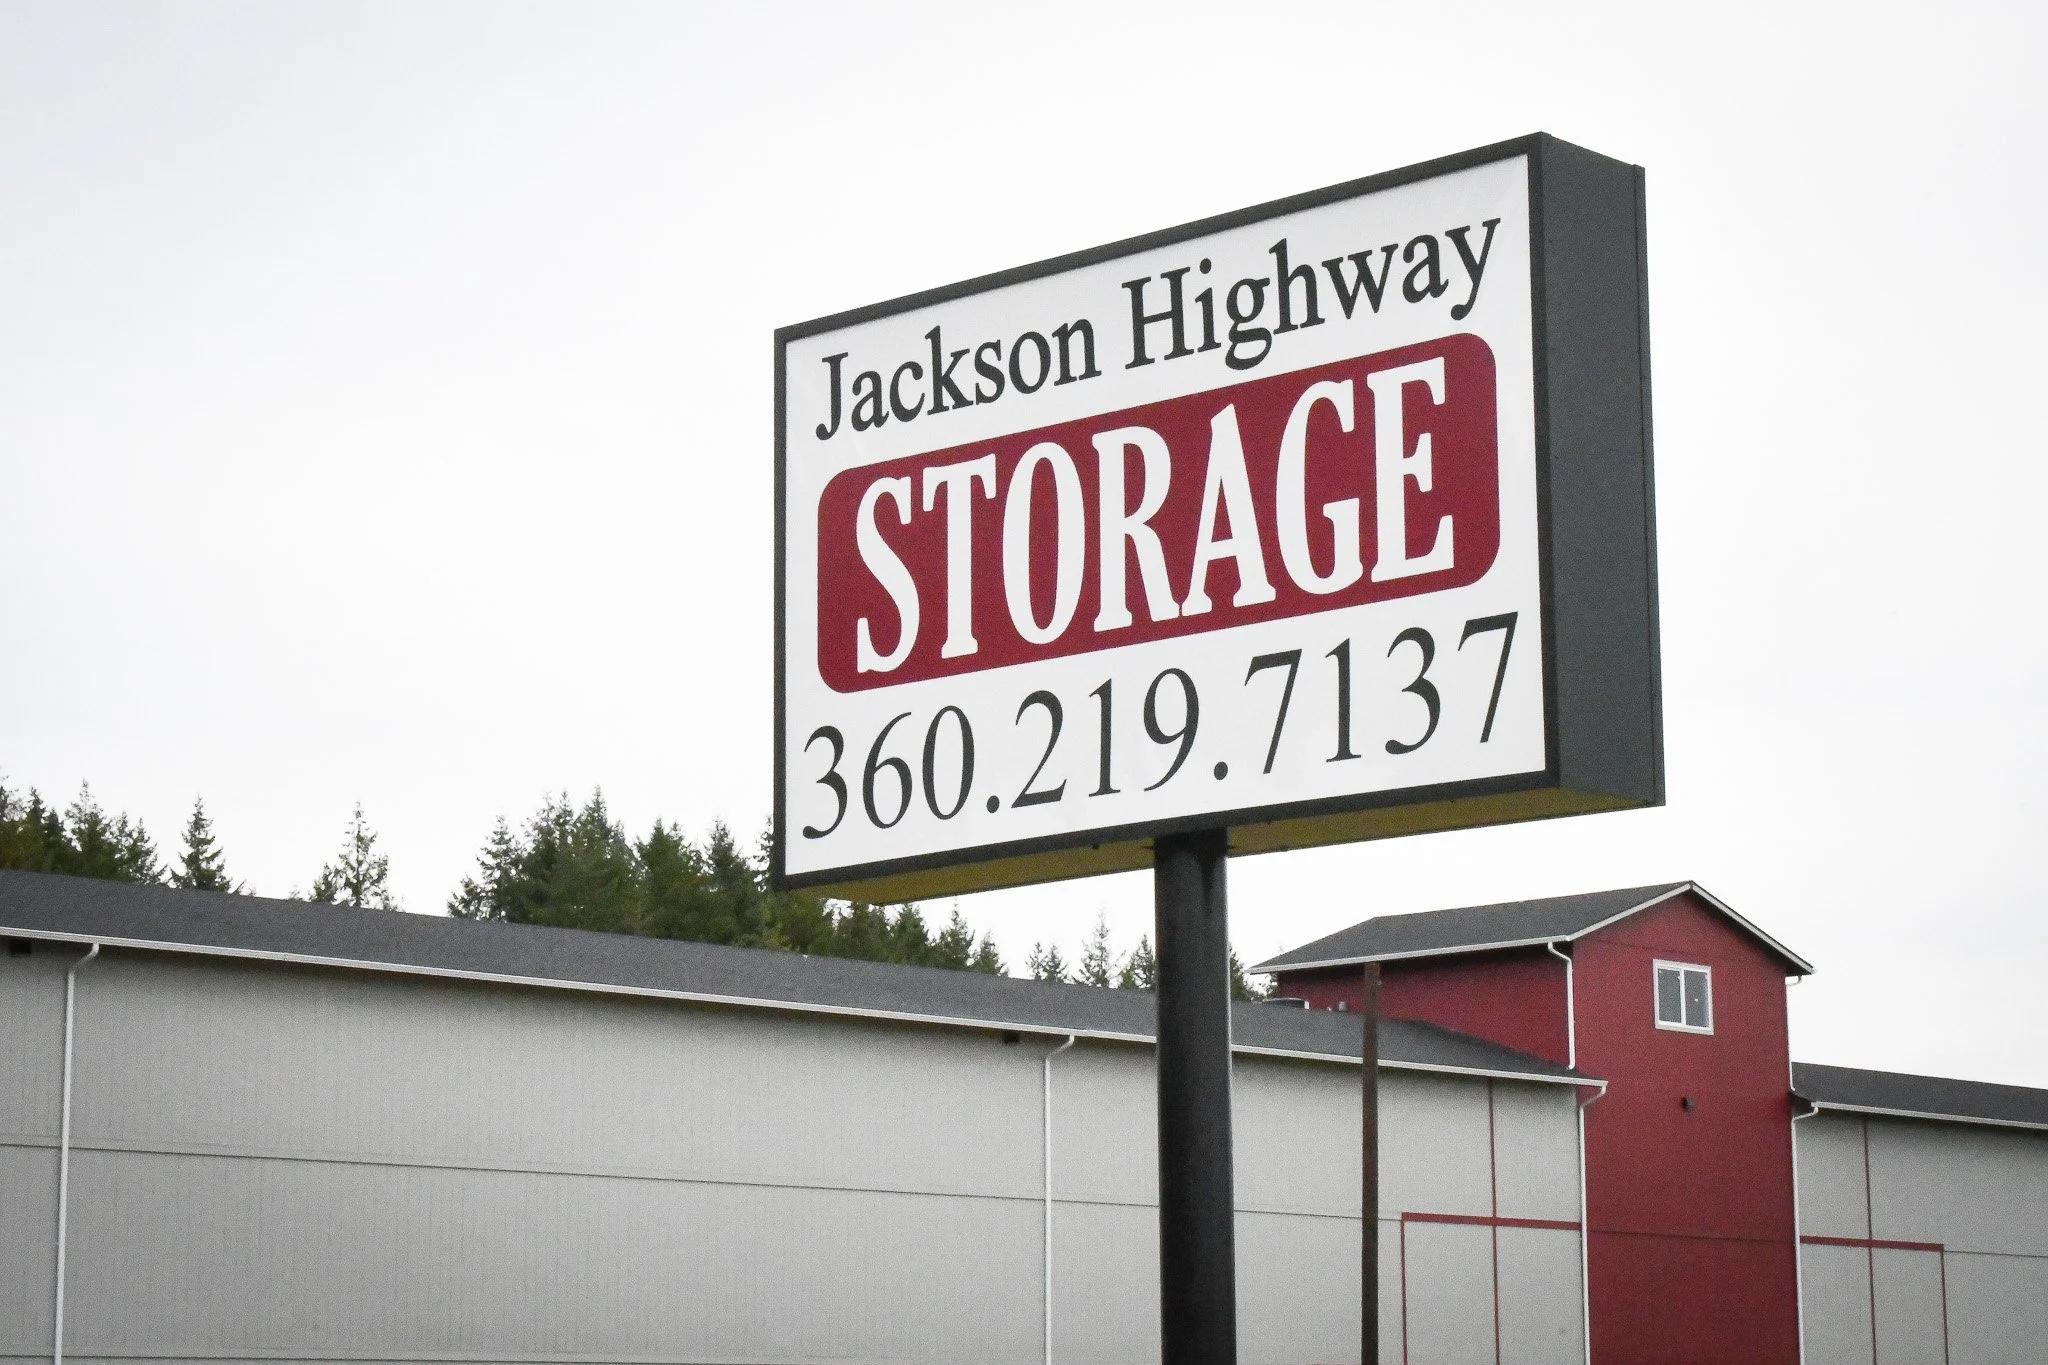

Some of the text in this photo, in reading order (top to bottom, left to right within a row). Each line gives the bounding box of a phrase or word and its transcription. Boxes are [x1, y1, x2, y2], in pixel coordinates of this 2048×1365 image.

[815, 217, 1501, 441] Jackson Highway
[855, 355, 1456, 674] STORAGE
[802, 611, 1519, 840] 360.219.7137
